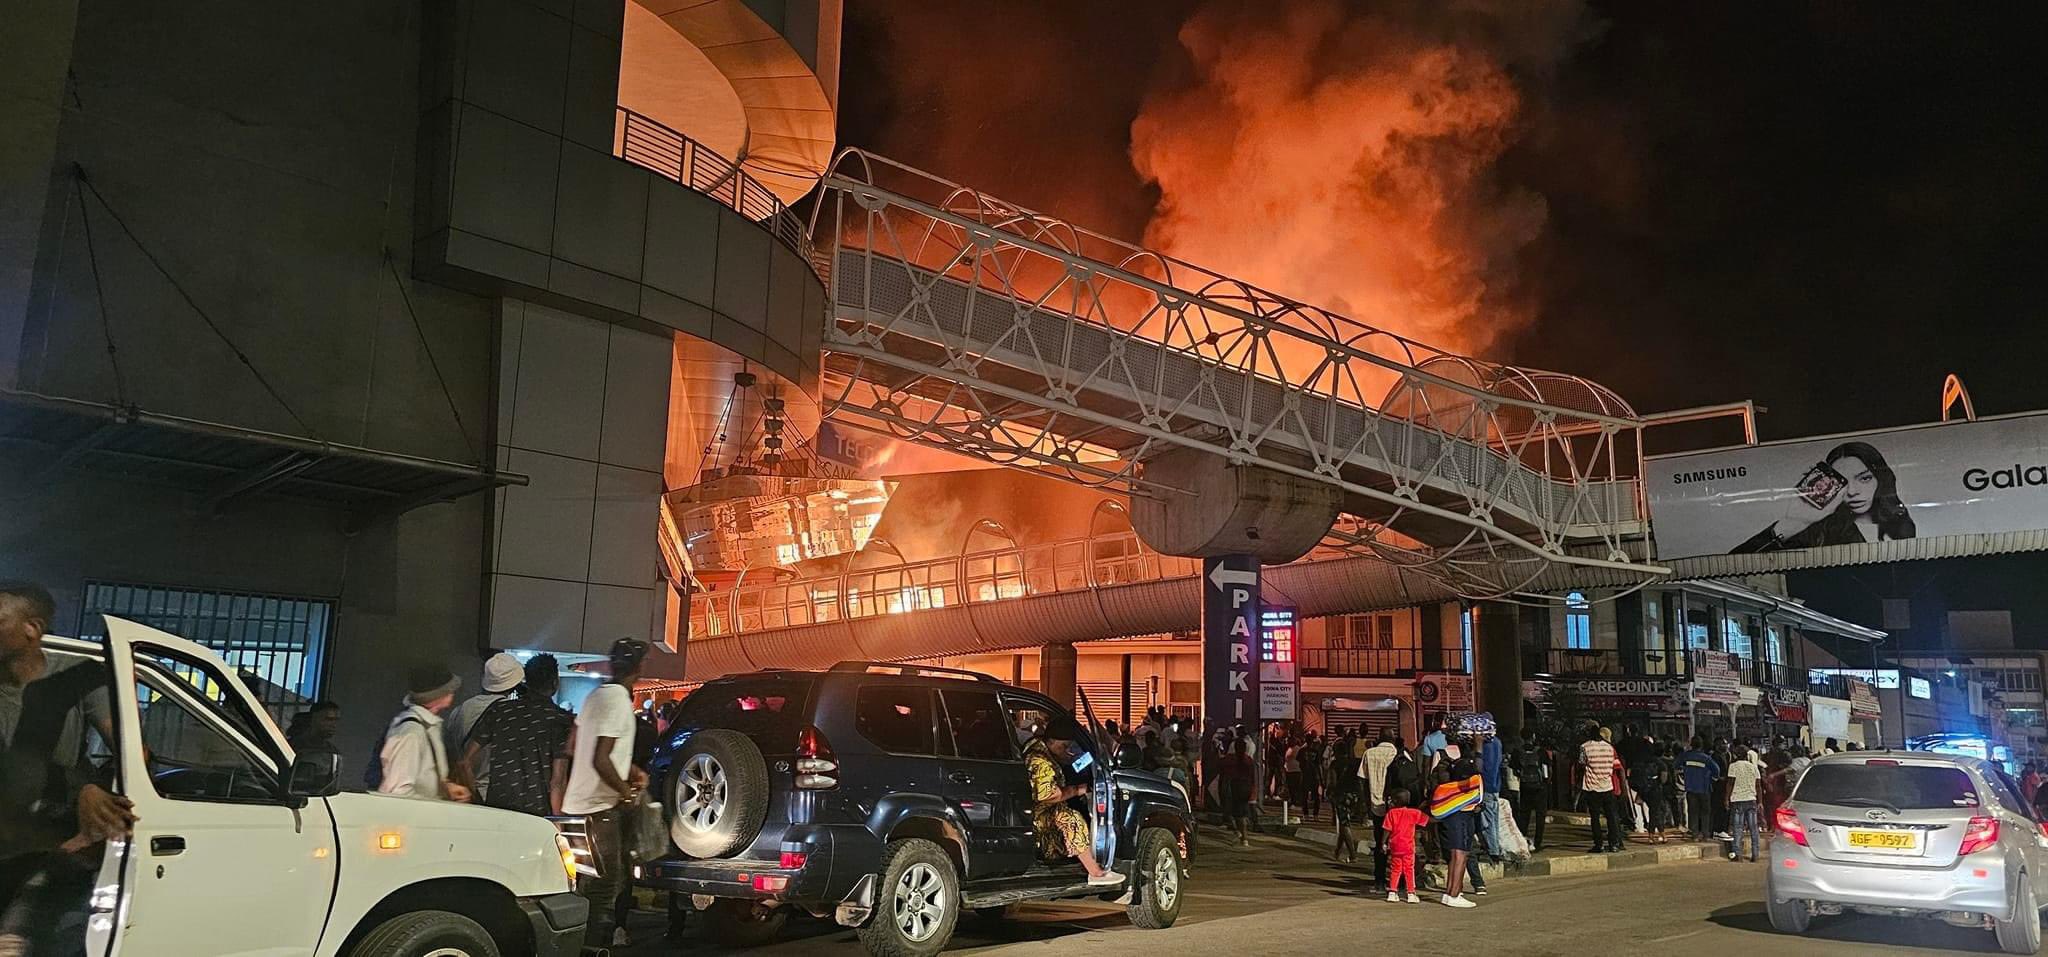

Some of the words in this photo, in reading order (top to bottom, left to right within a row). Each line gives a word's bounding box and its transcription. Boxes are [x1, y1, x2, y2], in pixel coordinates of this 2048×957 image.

[1673, 466, 1747, 484] SAMSUNG
[1962, 464, 2048, 491] Gala
[1577, 680, 1662, 693] CAREPOINT
[1879, 834, 1909, 846] 9597
